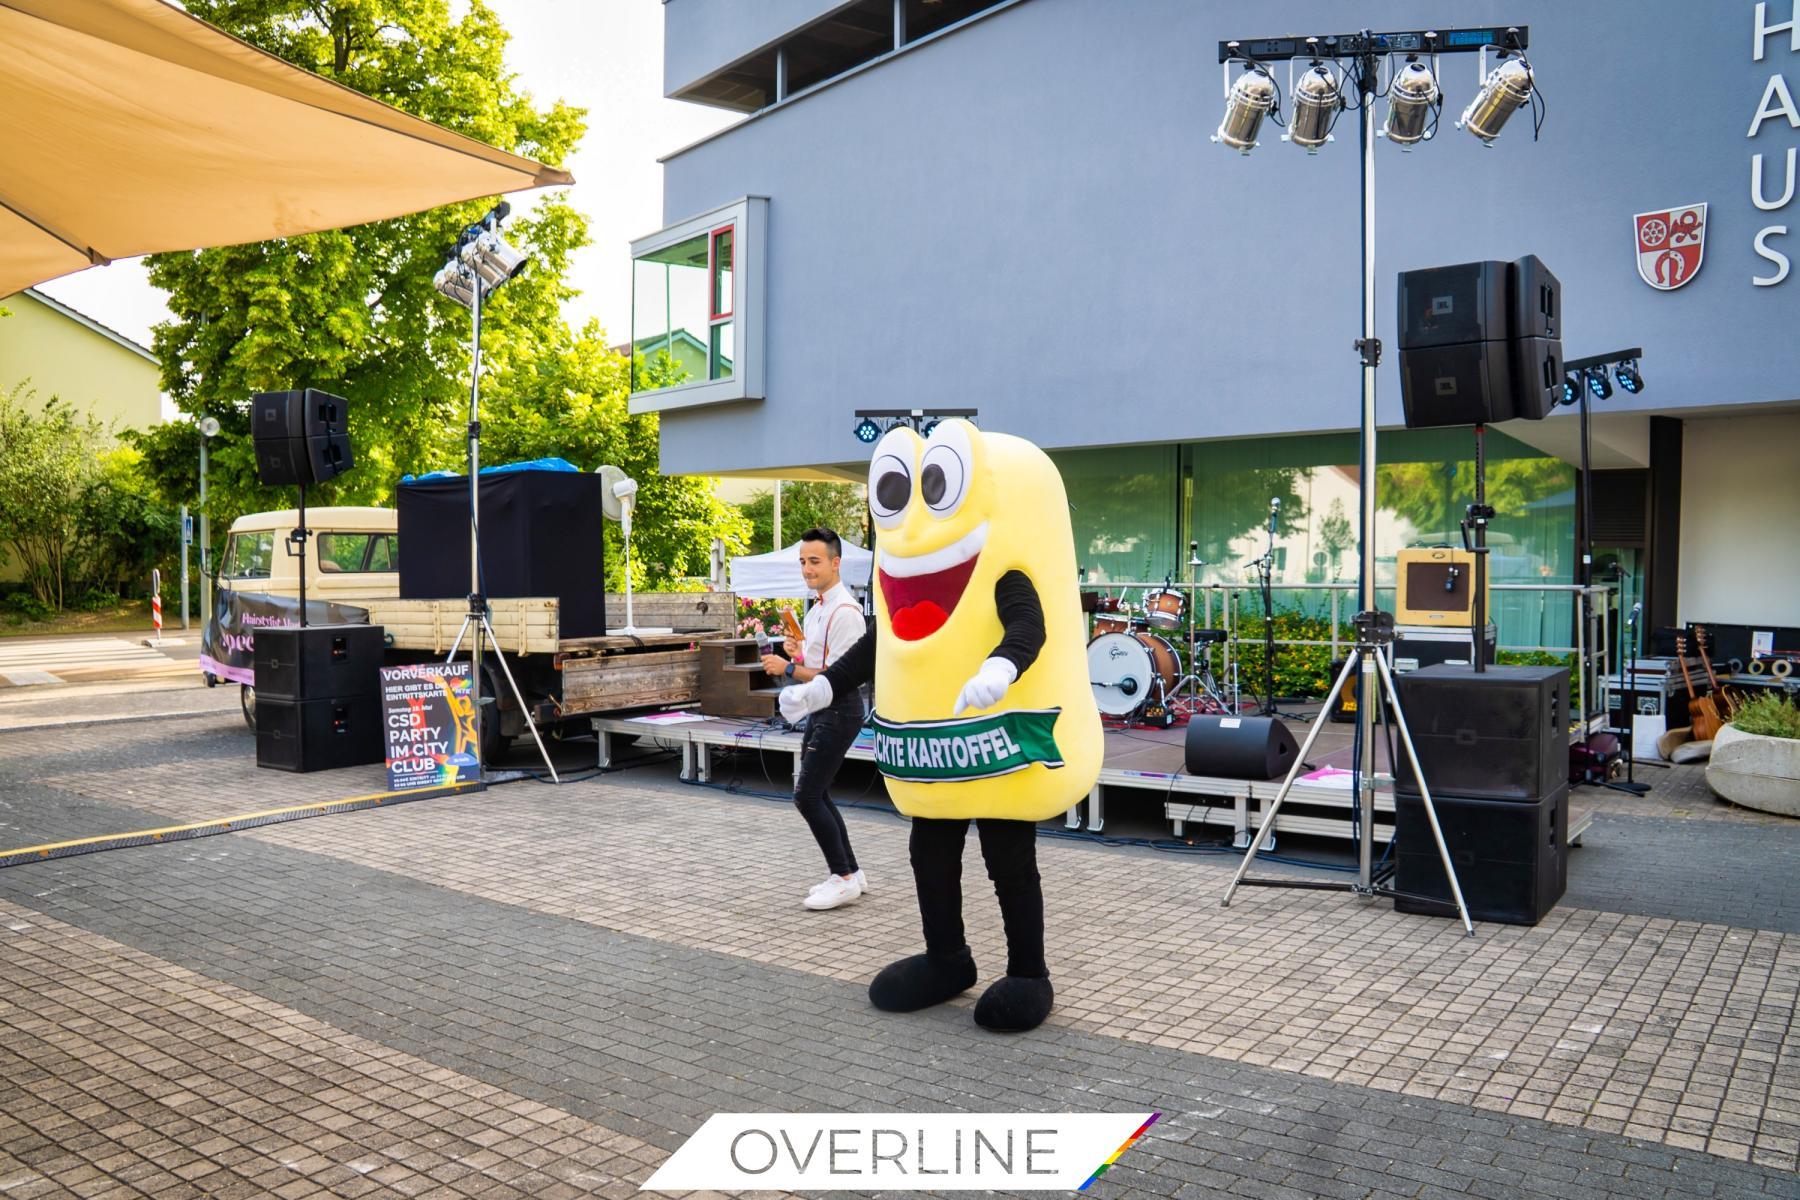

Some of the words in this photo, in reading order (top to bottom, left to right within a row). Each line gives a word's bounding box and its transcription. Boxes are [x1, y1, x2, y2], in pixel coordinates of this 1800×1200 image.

[383, 664, 469, 681] VORVERKAUF
[385, 685, 404, 694] HIER
[404, 684, 422, 692] GIBT
[388, 713, 421, 728] CSD
[389, 726, 441, 743] PARTY
[391, 744, 409, 758] IM
[412, 741, 449, 756] CITY
[907, 726, 1021, 768] KARTOFFEL
[391, 757, 436, 773] CLUB
